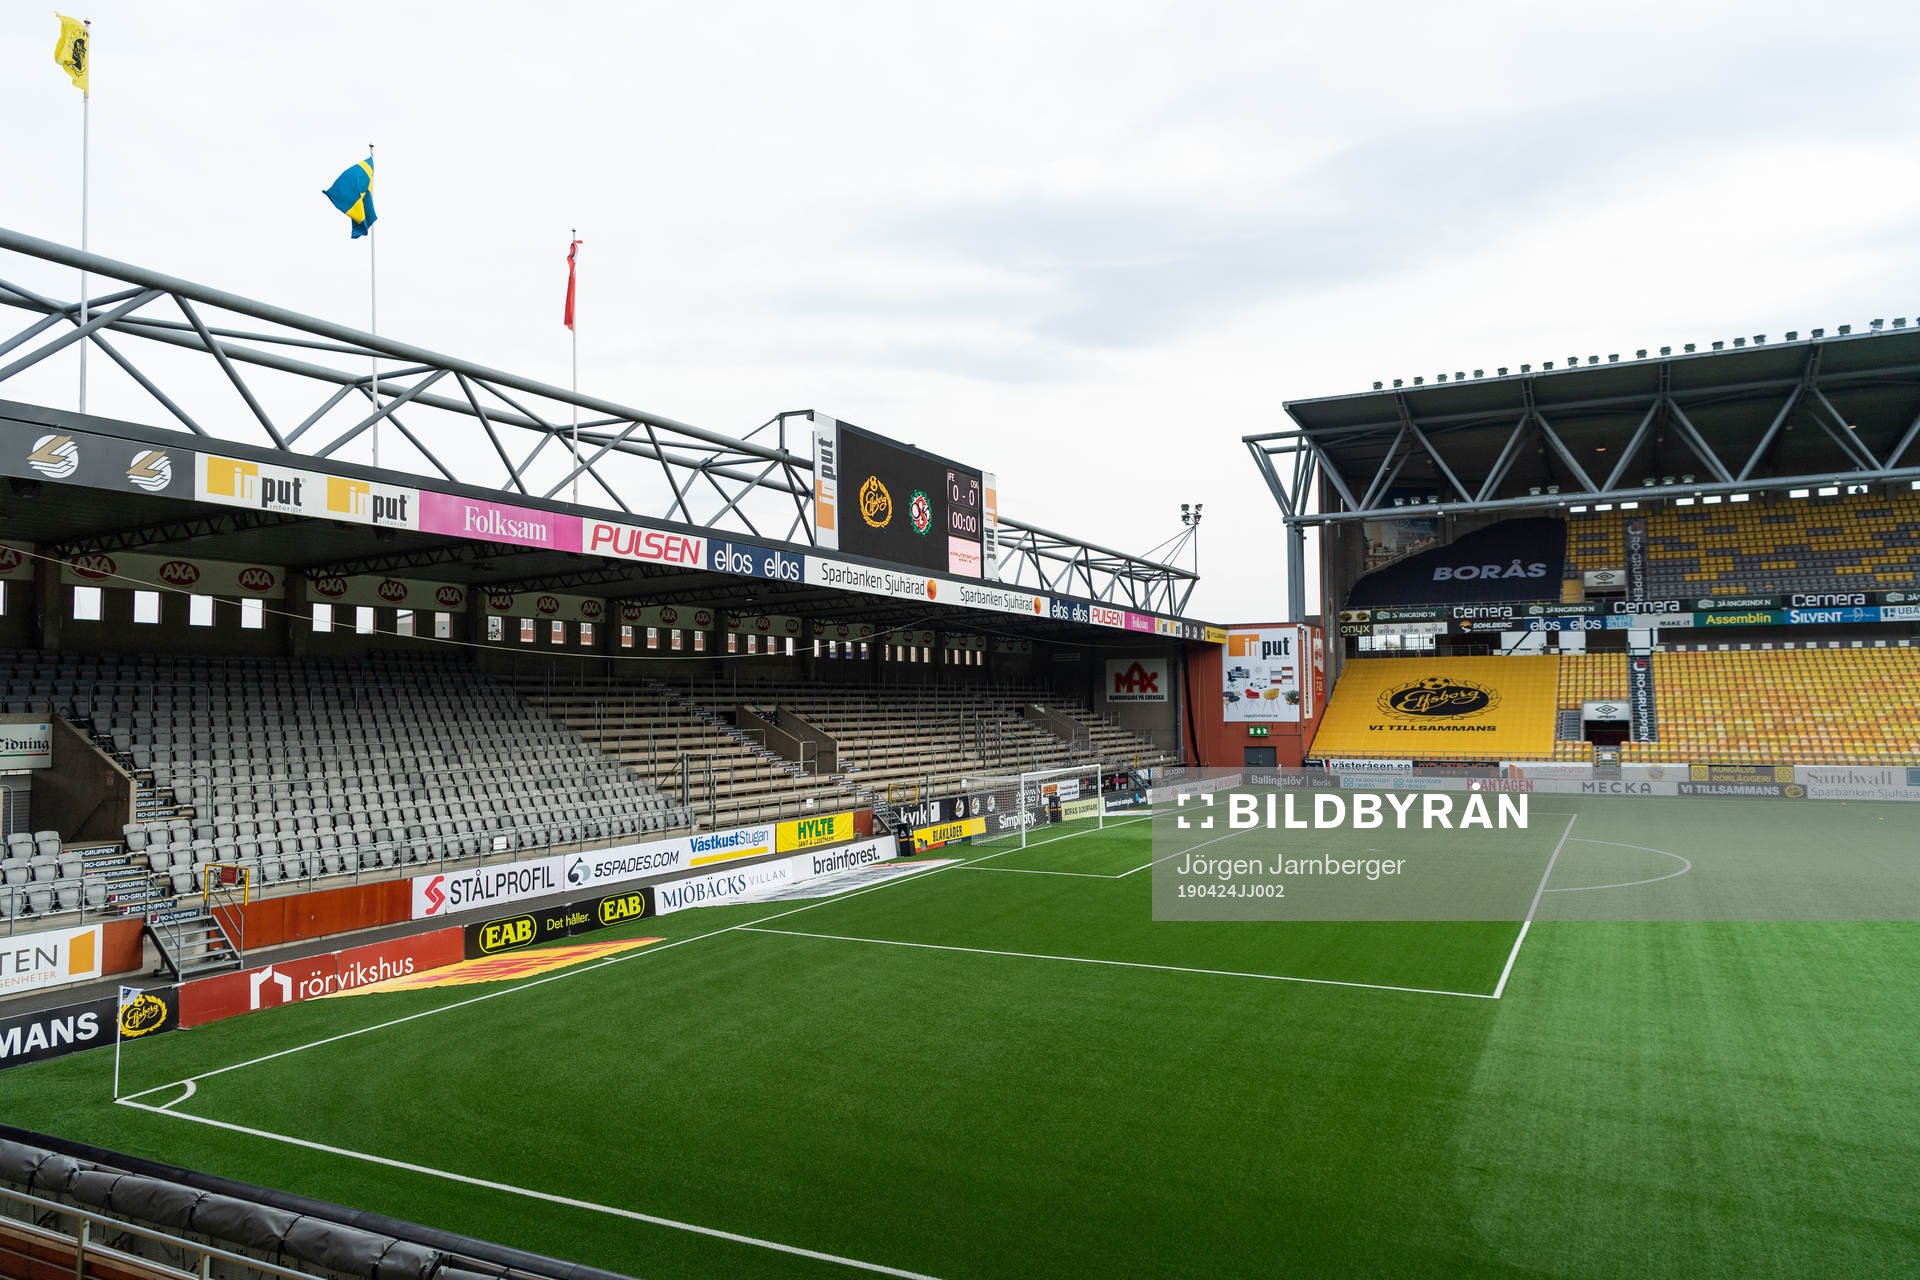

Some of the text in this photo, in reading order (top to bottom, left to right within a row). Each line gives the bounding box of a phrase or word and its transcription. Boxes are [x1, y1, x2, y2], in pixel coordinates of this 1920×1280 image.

[952, 484, 959, 502] 0
[968, 489, 975, 506] 0
[463, 505, 547, 542] Folksam
[952, 511, 976, 533] 00:00
[590, 524, 701, 565] PULSEN
[76, 555, 112, 573] AXA
[714, 543, 753, 574] ellos
[764, 551, 800, 581] ellos
[163, 564, 195, 580] AXA
[1433, 558, 1548, 581] BORÅS
[241, 571, 272, 586] AXA
[317, 578, 345, 592] AXA
[821, 562, 925, 596] Sparbanken Sjuhärad
[380, 583, 405, 598] AXA
[438, 590, 462, 603] AXA
[538, 599, 558, 610] AXA
[960, 587, 1033, 612] Sparbanken Sjuhärad
[1614, 601, 1680, 614] Cernera
[1791, 592, 1866, 608] Cernera
[582, 603, 600, 614] AXA
[661, 609, 677, 622] AXA
[1091, 608, 1124, 626] PULSEN
[1453, 606, 1513, 619] Cernera
[1790, 609, 1843, 625] SILVENT
[1529, 617, 1561, 631] ellos
[1569, 616, 1602, 630] ellos
[1705, 613, 1772, 626] Assemblin
[1340, 624, 1370, 635] onyx
[1114, 661, 1159, 694] MAX
[1636, 673, 1650, 741] RO-GRUPPEN
[1388, 724, 1497, 732] TILLSAMMANS
[1332, 761, 1411, 773] västeråsen.se
[1251, 775, 1331, 788] Ballingslöv Borås
[1712, 774, 1772, 783] RÖRLÄGGERI
[1807, 769, 1892, 785] Sandwall
[1582, 781, 1651, 794] MECKA
[1681, 784, 1693, 794] VI
[1694, 785, 1780, 796] TILLSAMMANS
[1811, 787, 1875, 799] Sparbanken
[900, 803, 927, 826] kvik
[798, 817, 834, 840] HYLTE
[690, 828, 769, 853] VästkustStugan
[84, 858, 126, 868] RO-GRUPPEN
[594, 851, 680, 878] 5SPADES.COM
[813, 843, 881, 875] brainforest.
[449, 869, 555, 905] STÅLPROFIL
[660, 869, 786, 910] MJÖBÄCKS VILLAN
[603, 895, 642, 921] EAB
[547, 912, 590, 932] Det håller.
[485, 919, 532, 947] EAB
[299, 955, 415, 999] rörvikshus
[0, 1012, 98, 1059] MANS
